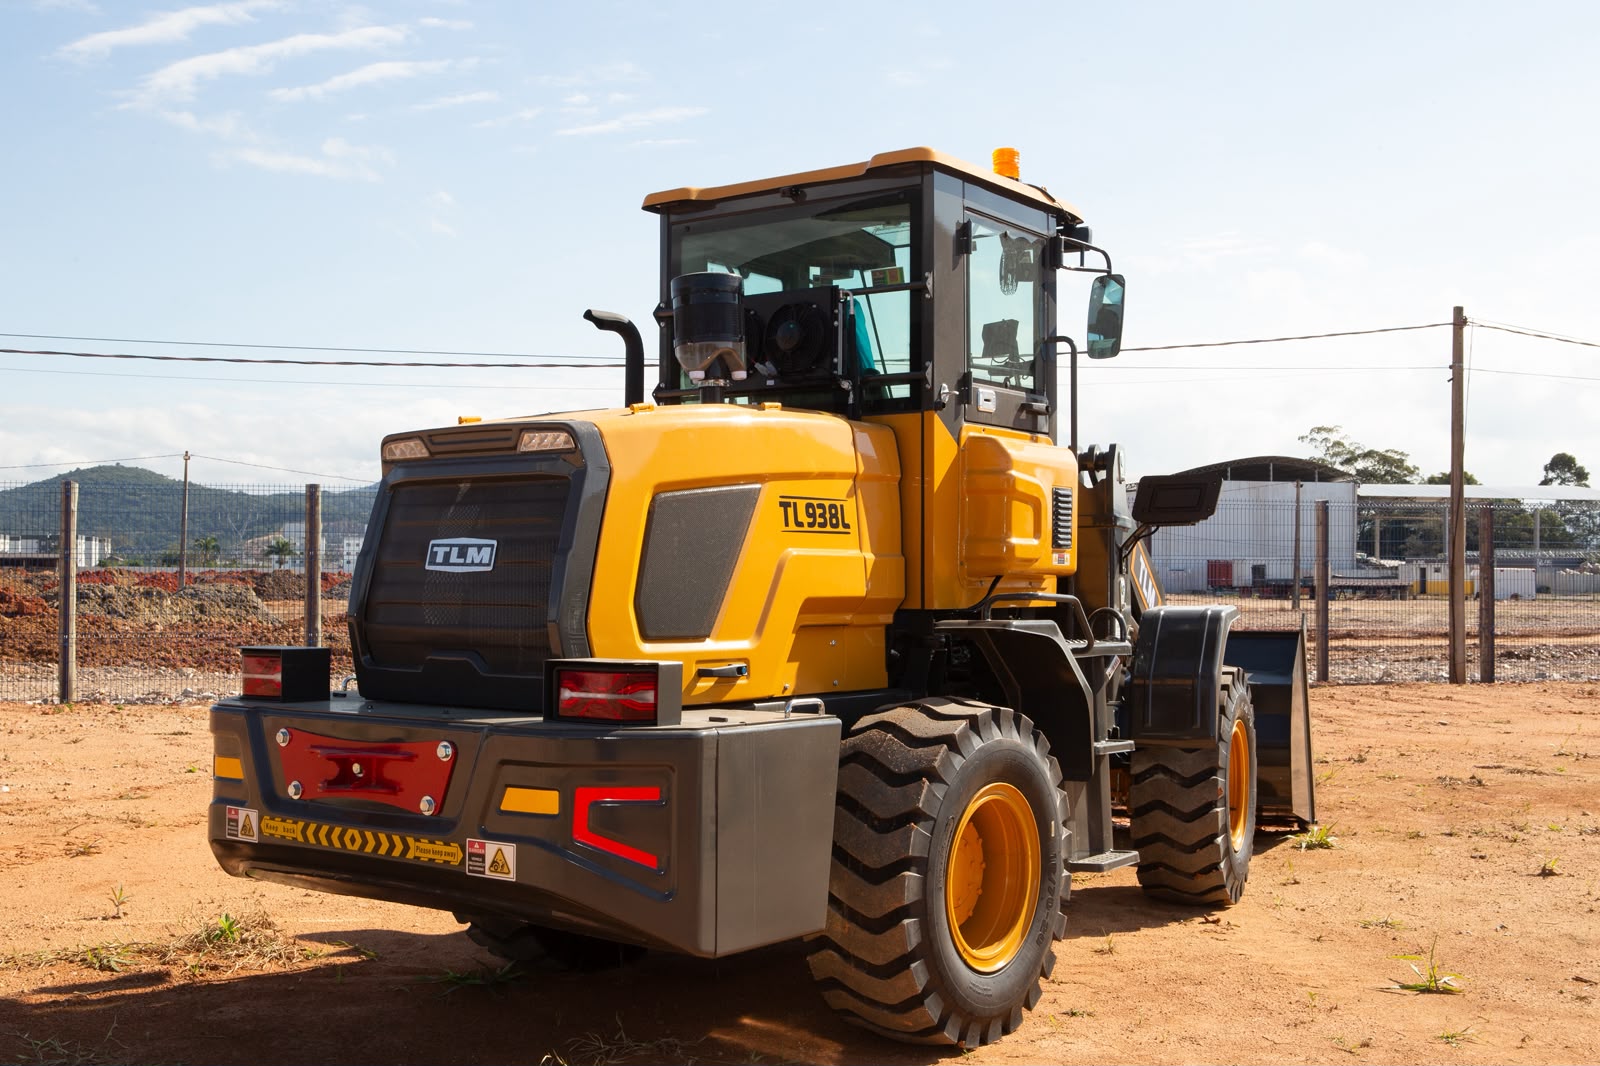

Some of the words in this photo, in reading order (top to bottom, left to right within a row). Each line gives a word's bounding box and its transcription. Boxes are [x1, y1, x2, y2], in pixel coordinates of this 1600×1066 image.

[779, 501, 851, 529] TL938L
[433, 546, 492, 564] TLM
[265, 822, 279, 832] Keep
[283, 825, 296, 834] back
[415, 845, 431, 855] Please
[431, 848, 443, 857] keep
[444, 850, 456, 860] away
